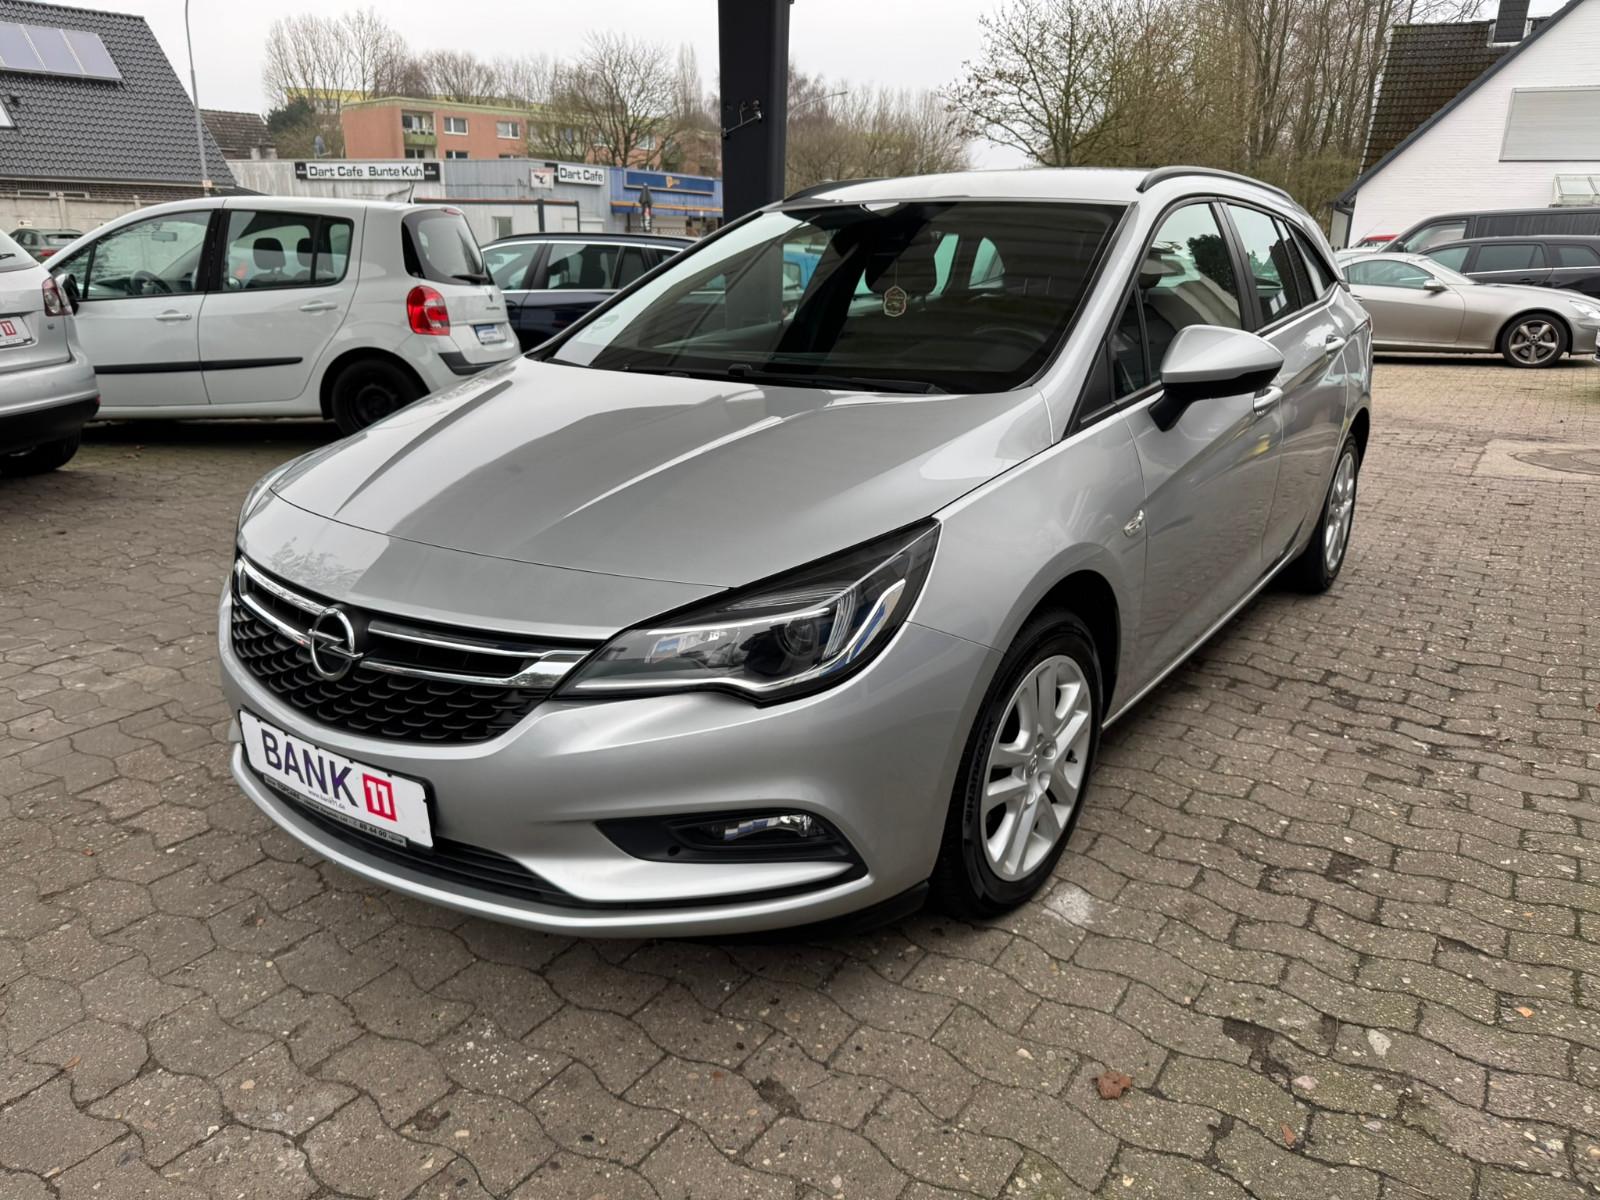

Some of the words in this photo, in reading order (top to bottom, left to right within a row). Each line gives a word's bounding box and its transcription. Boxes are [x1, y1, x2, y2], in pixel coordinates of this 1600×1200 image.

[309, 166, 335, 177] Dart
[337, 166, 363, 177] Cafe
[368, 166, 399, 177] Bunte
[401, 166, 423, 177] Kuh
[560, 167, 582, 180] Dart
[583, 169, 603, 182] Cafe
[261, 728, 359, 808] BANK
[365, 777, 394, 818] 11
